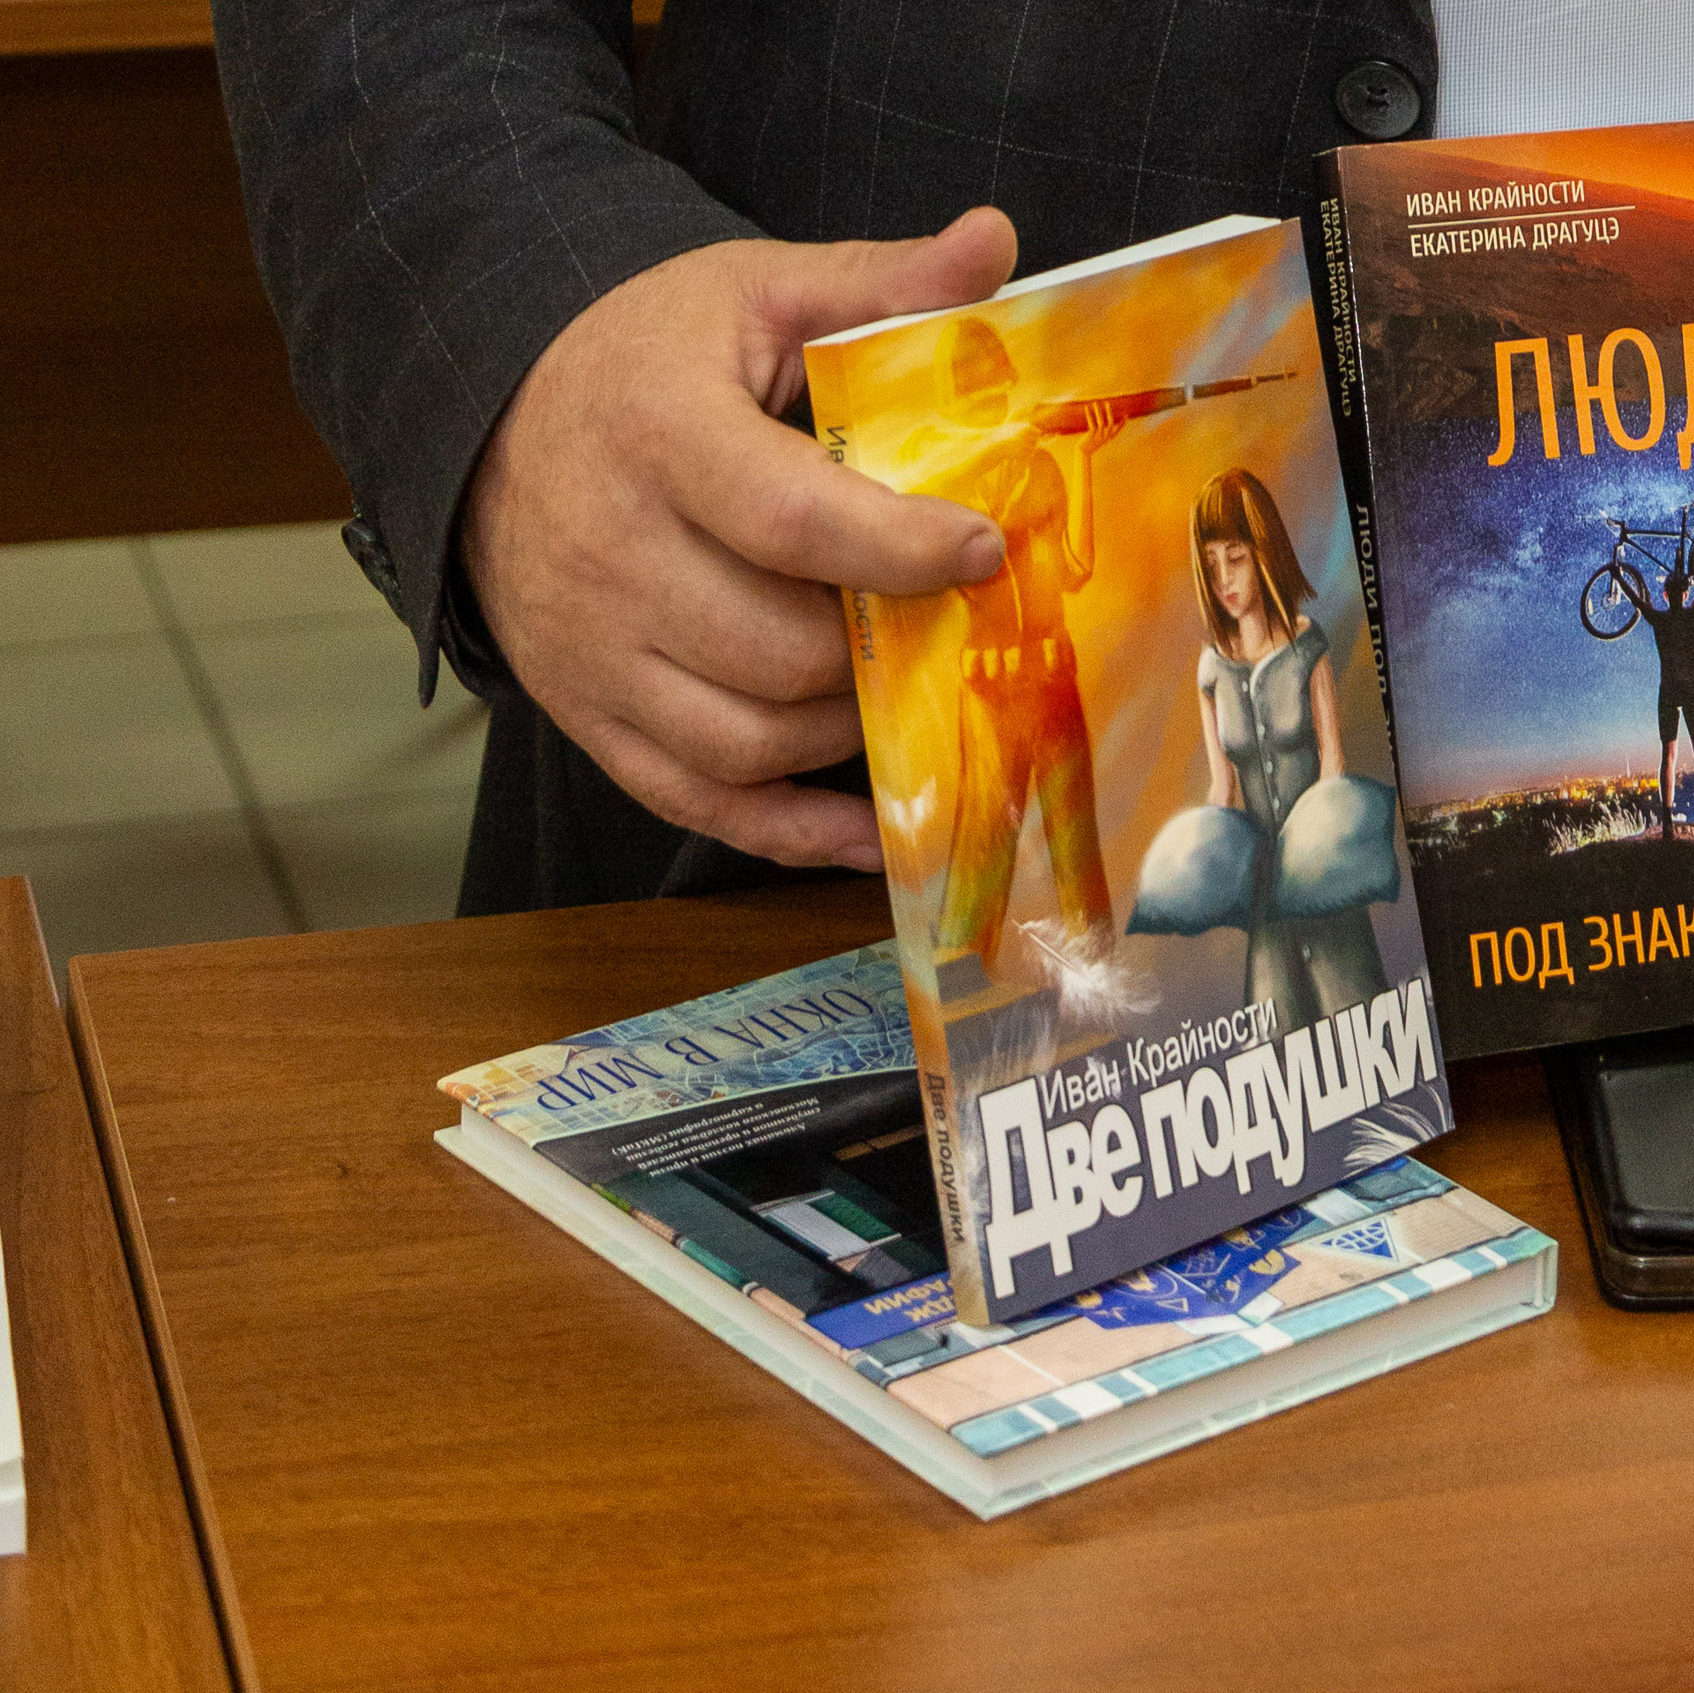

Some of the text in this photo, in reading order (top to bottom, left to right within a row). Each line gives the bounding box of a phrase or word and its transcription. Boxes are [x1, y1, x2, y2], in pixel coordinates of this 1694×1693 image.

[1405, 178, 1586, 219] ИВАН КРАЙНОСТИ
[1409, 216, 1621, 259] ЕКАТЕРИНА ДРАГУЦЭ
[1319, 199, 1353, 418] ЕКАТЕРИНА ДРАГУЦЭ
[1329, 196, 1358, 384] ИВАН КРАЙНОСТИ
[826, 425, 848, 466] Ив
[1355, 502, 1379, 610] ЛЮДИ
[1467, 920, 1576, 990] ПОД
[534, 987, 876, 1112] ОКНА В МИР
[1039, 996, 1279, 1120] Иван Крайности
[924, 1070, 967, 1245] Две подушки
[977, 977, 1440, 1301] Две подушки
